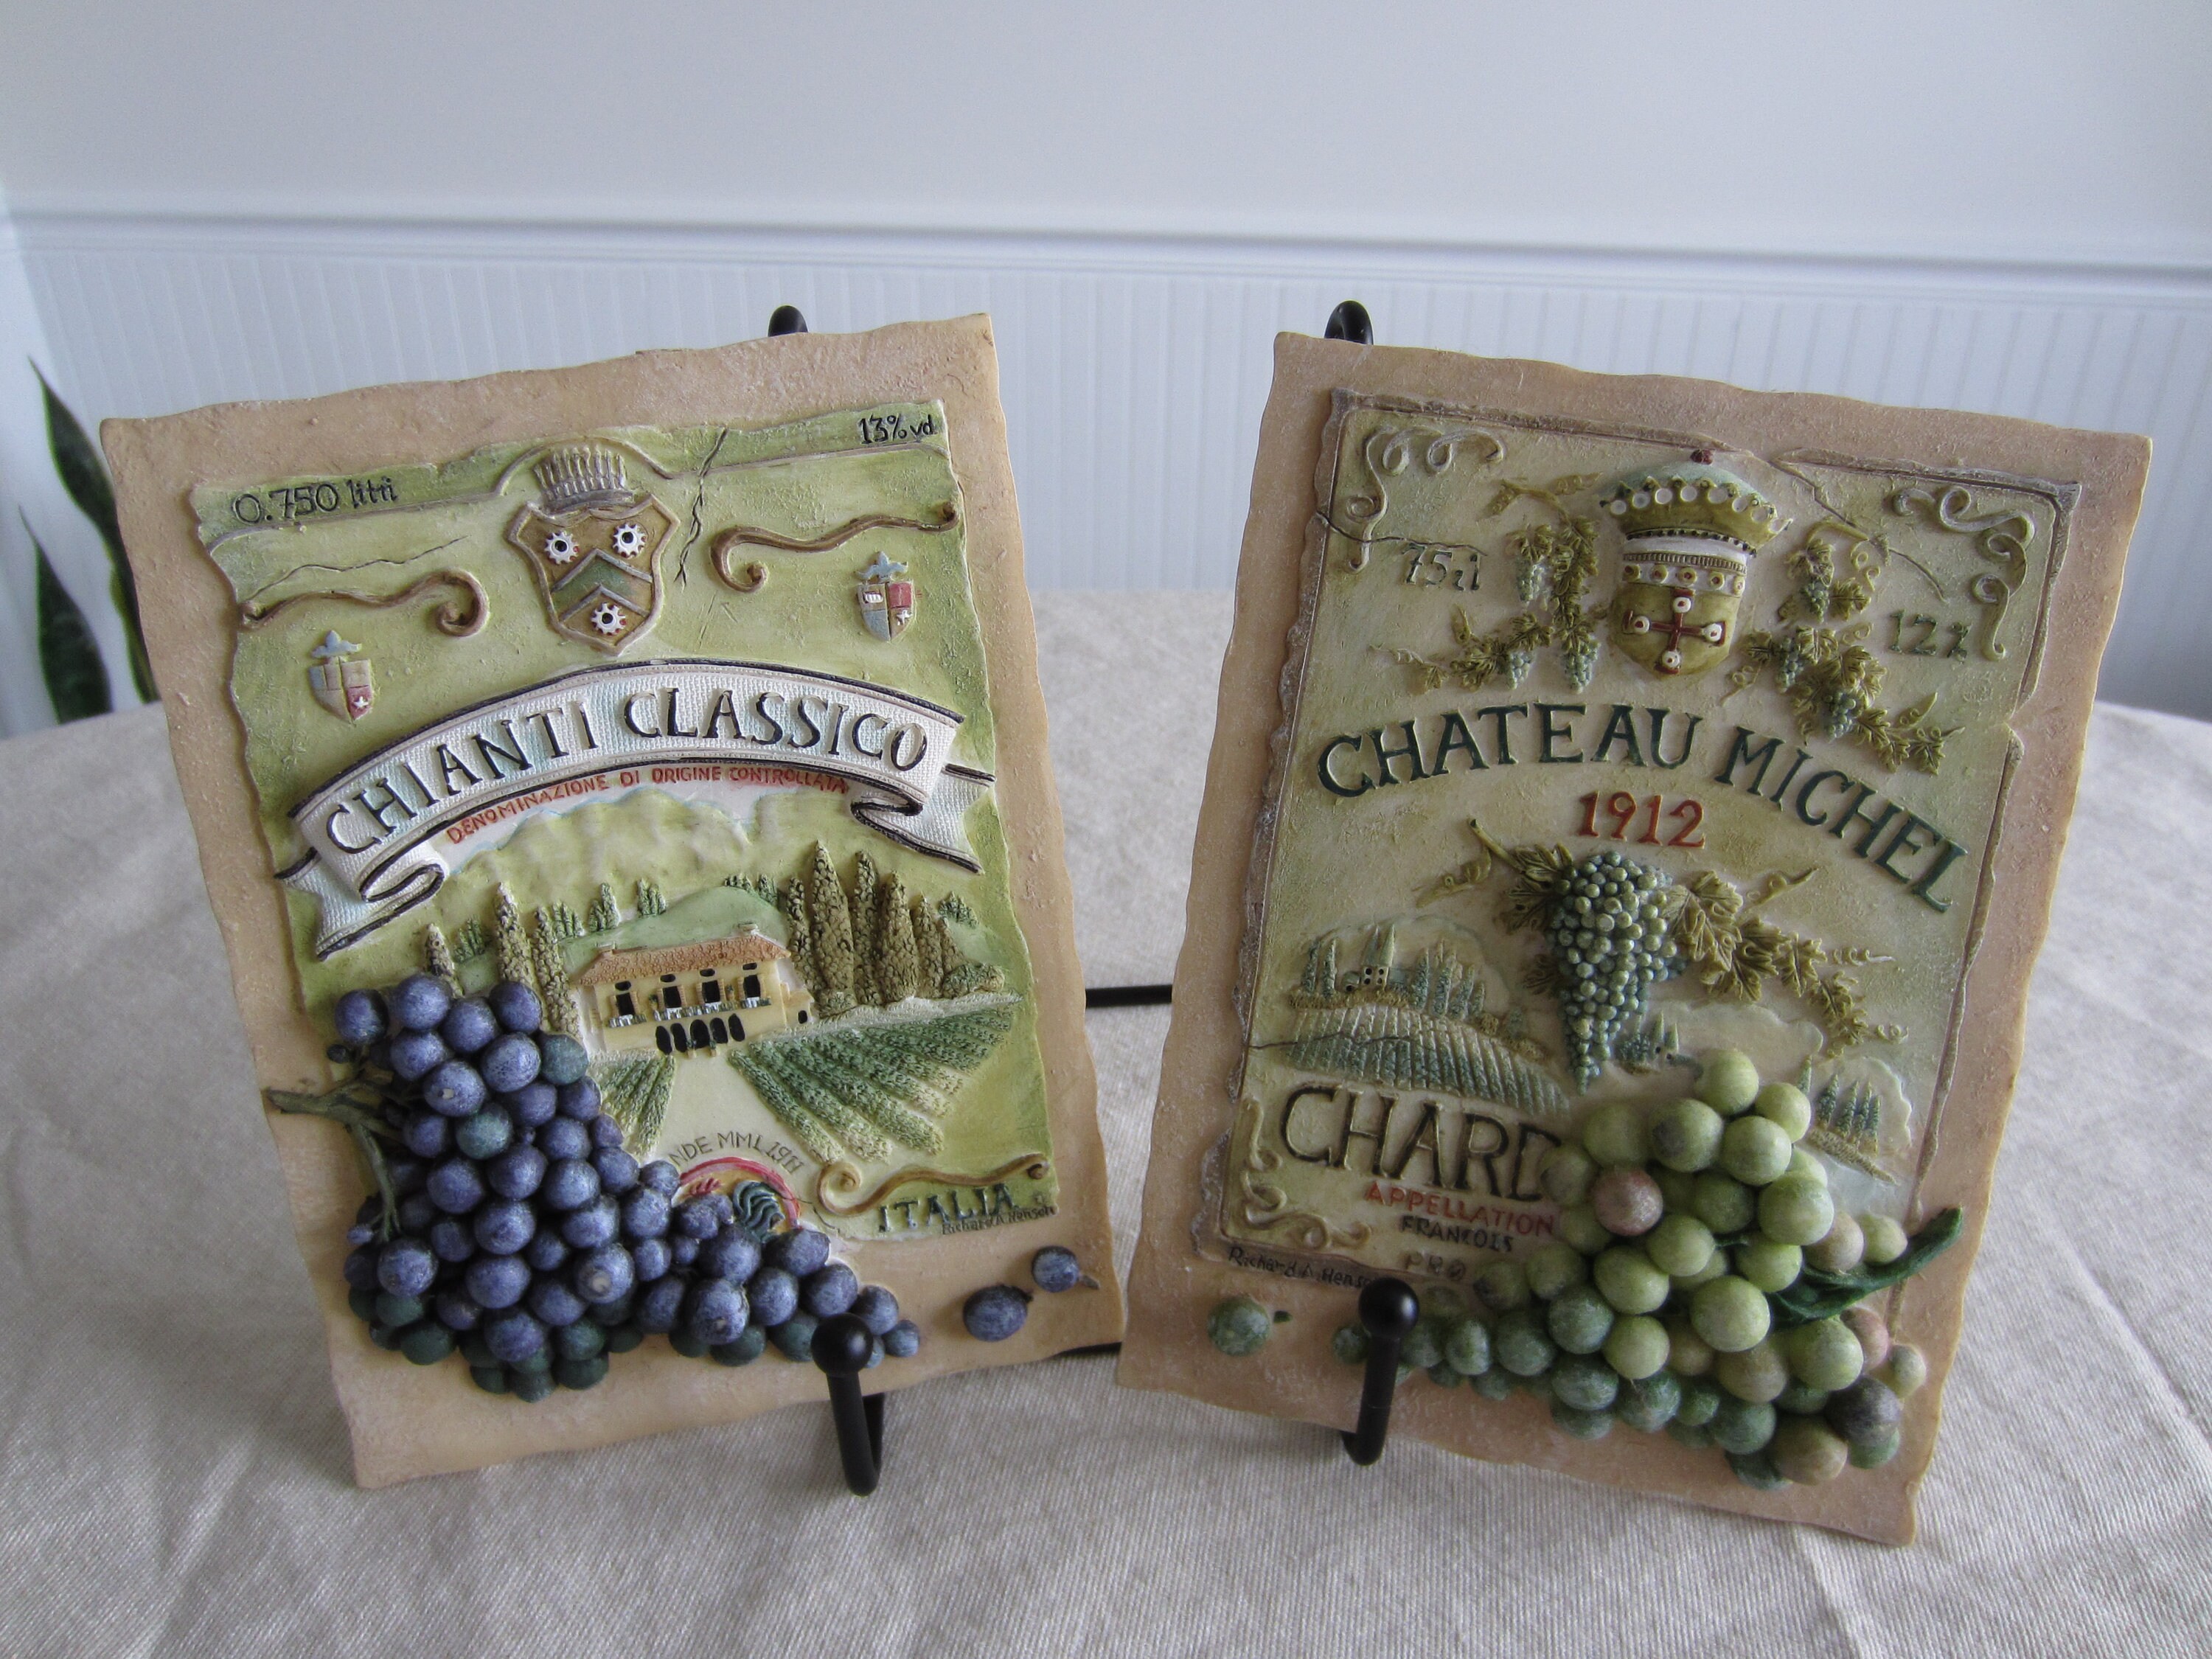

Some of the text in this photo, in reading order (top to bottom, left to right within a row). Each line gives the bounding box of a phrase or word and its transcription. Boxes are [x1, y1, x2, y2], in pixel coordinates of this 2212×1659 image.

[231, 483, 339, 524] 0.750
[326, 687, 929, 854] CHIANTI CLASSICO
[446, 773, 611, 845] DENOMINAZIONE
[619, 769, 641, 788] DI
[652, 766, 723, 785] ORIGINE
[1317, 700, 1968, 914] CHATEAU MICHEL
[1579, 790, 1705, 848] 1912
[878, 1182, 1021, 1234] ITALIA
[1366, 1182, 1554, 1237] APPELLATION
[1228, 1245, 1298, 1278] Richard
